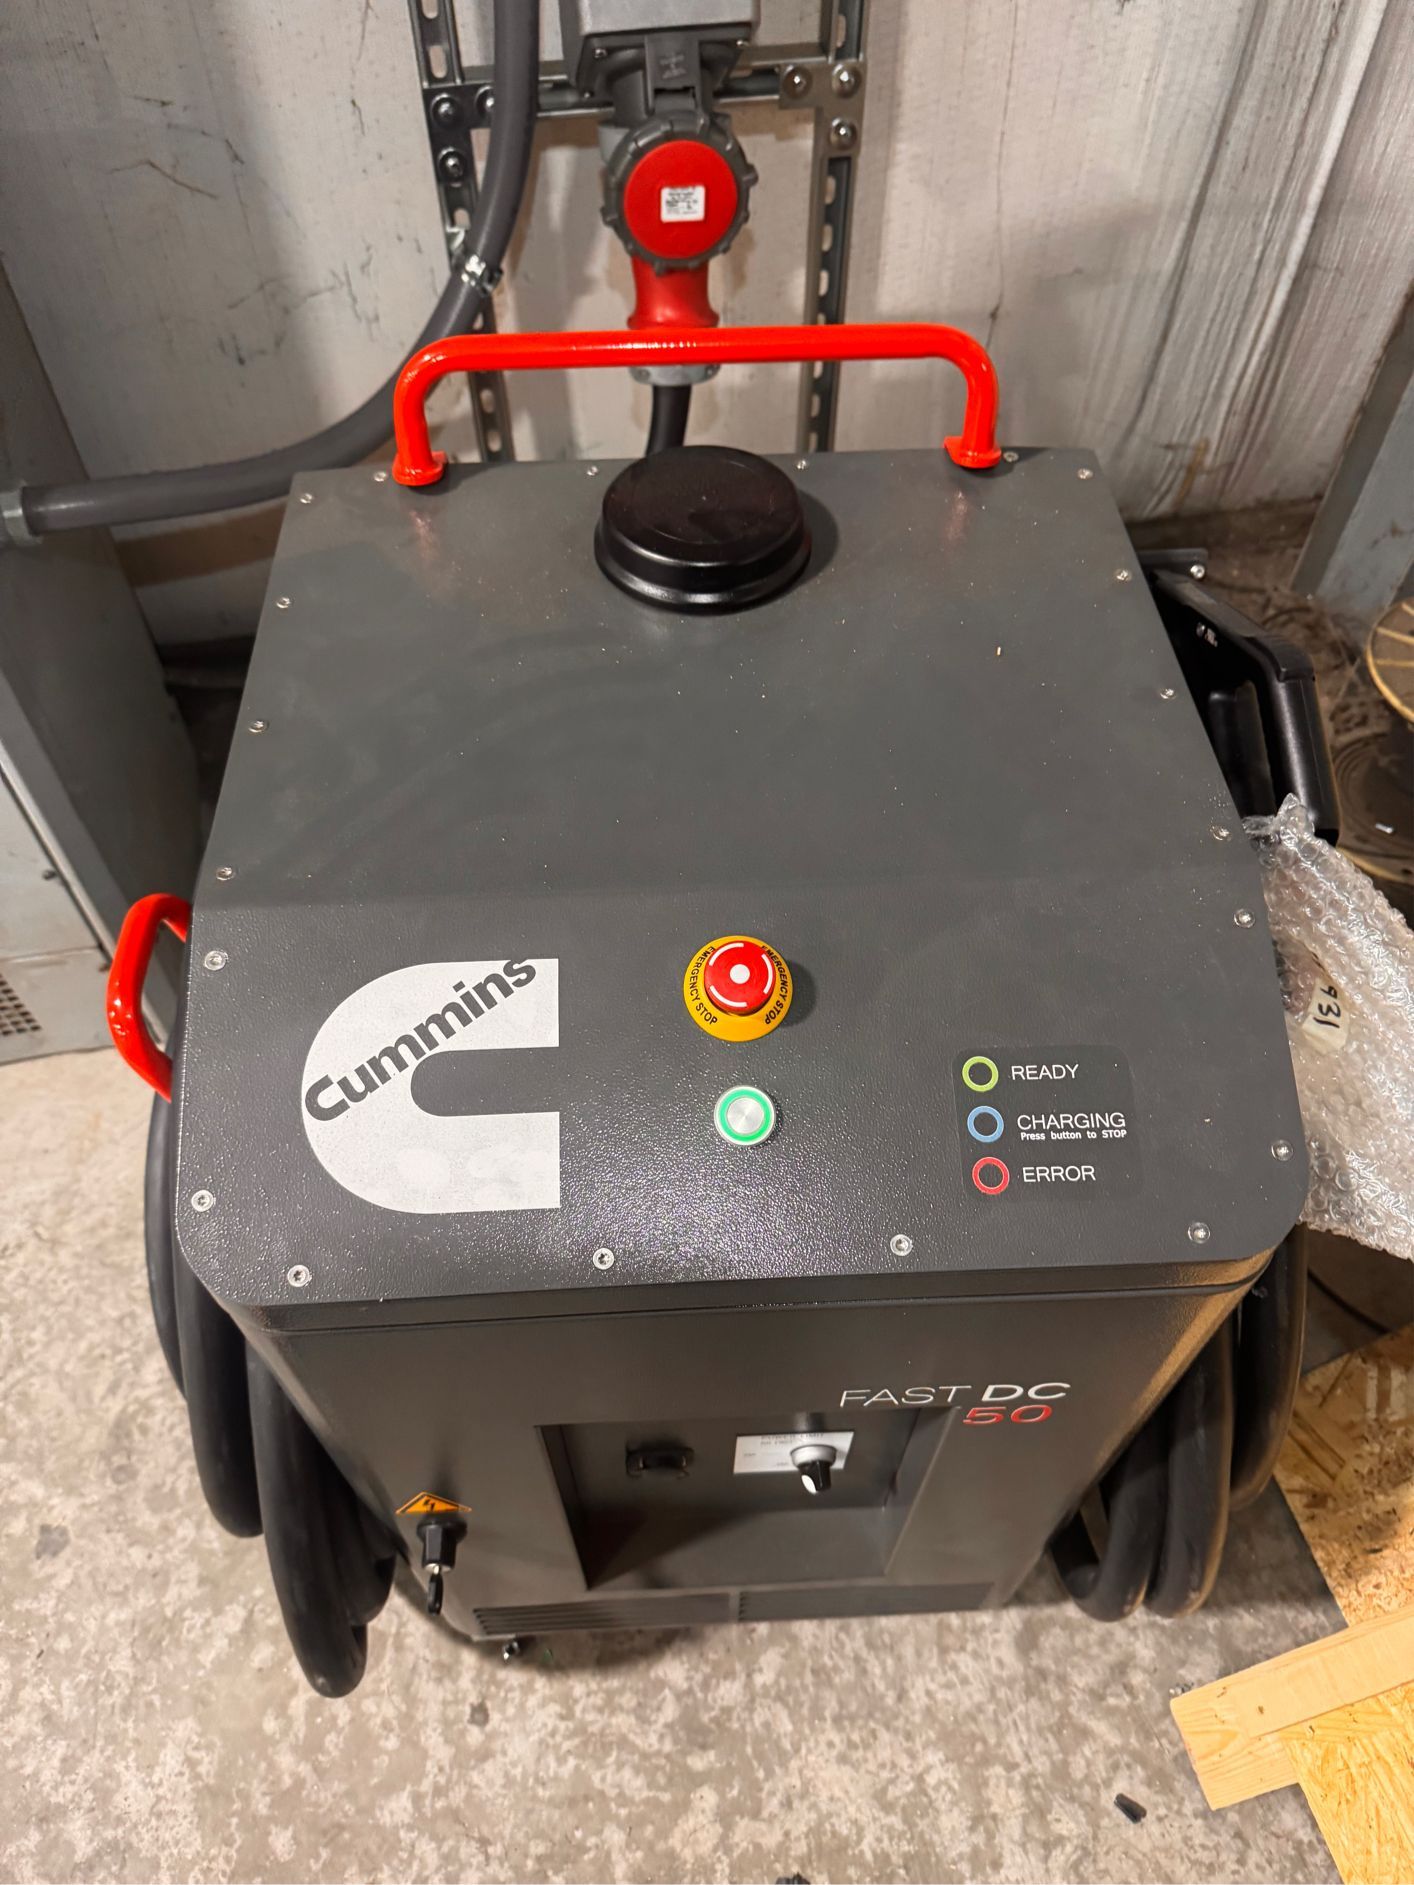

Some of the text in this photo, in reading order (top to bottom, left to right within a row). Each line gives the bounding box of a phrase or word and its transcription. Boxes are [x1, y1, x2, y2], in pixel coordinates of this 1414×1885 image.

[689, 946, 718, 1025] EMERGENCY STOP
[764, 1000, 784, 1025] STOP
[304, 959, 537, 1122] Cummins
[1011, 1063, 1079, 1081] READY
[1017, 1112, 1126, 1131] CHARGING
[1020, 1129, 1127, 1141] Press button to STOP
[1022, 1165, 1096, 1183] ERROR
[839, 1382, 1071, 1408] FAST DC
[962, 1404, 1053, 1425] 50
